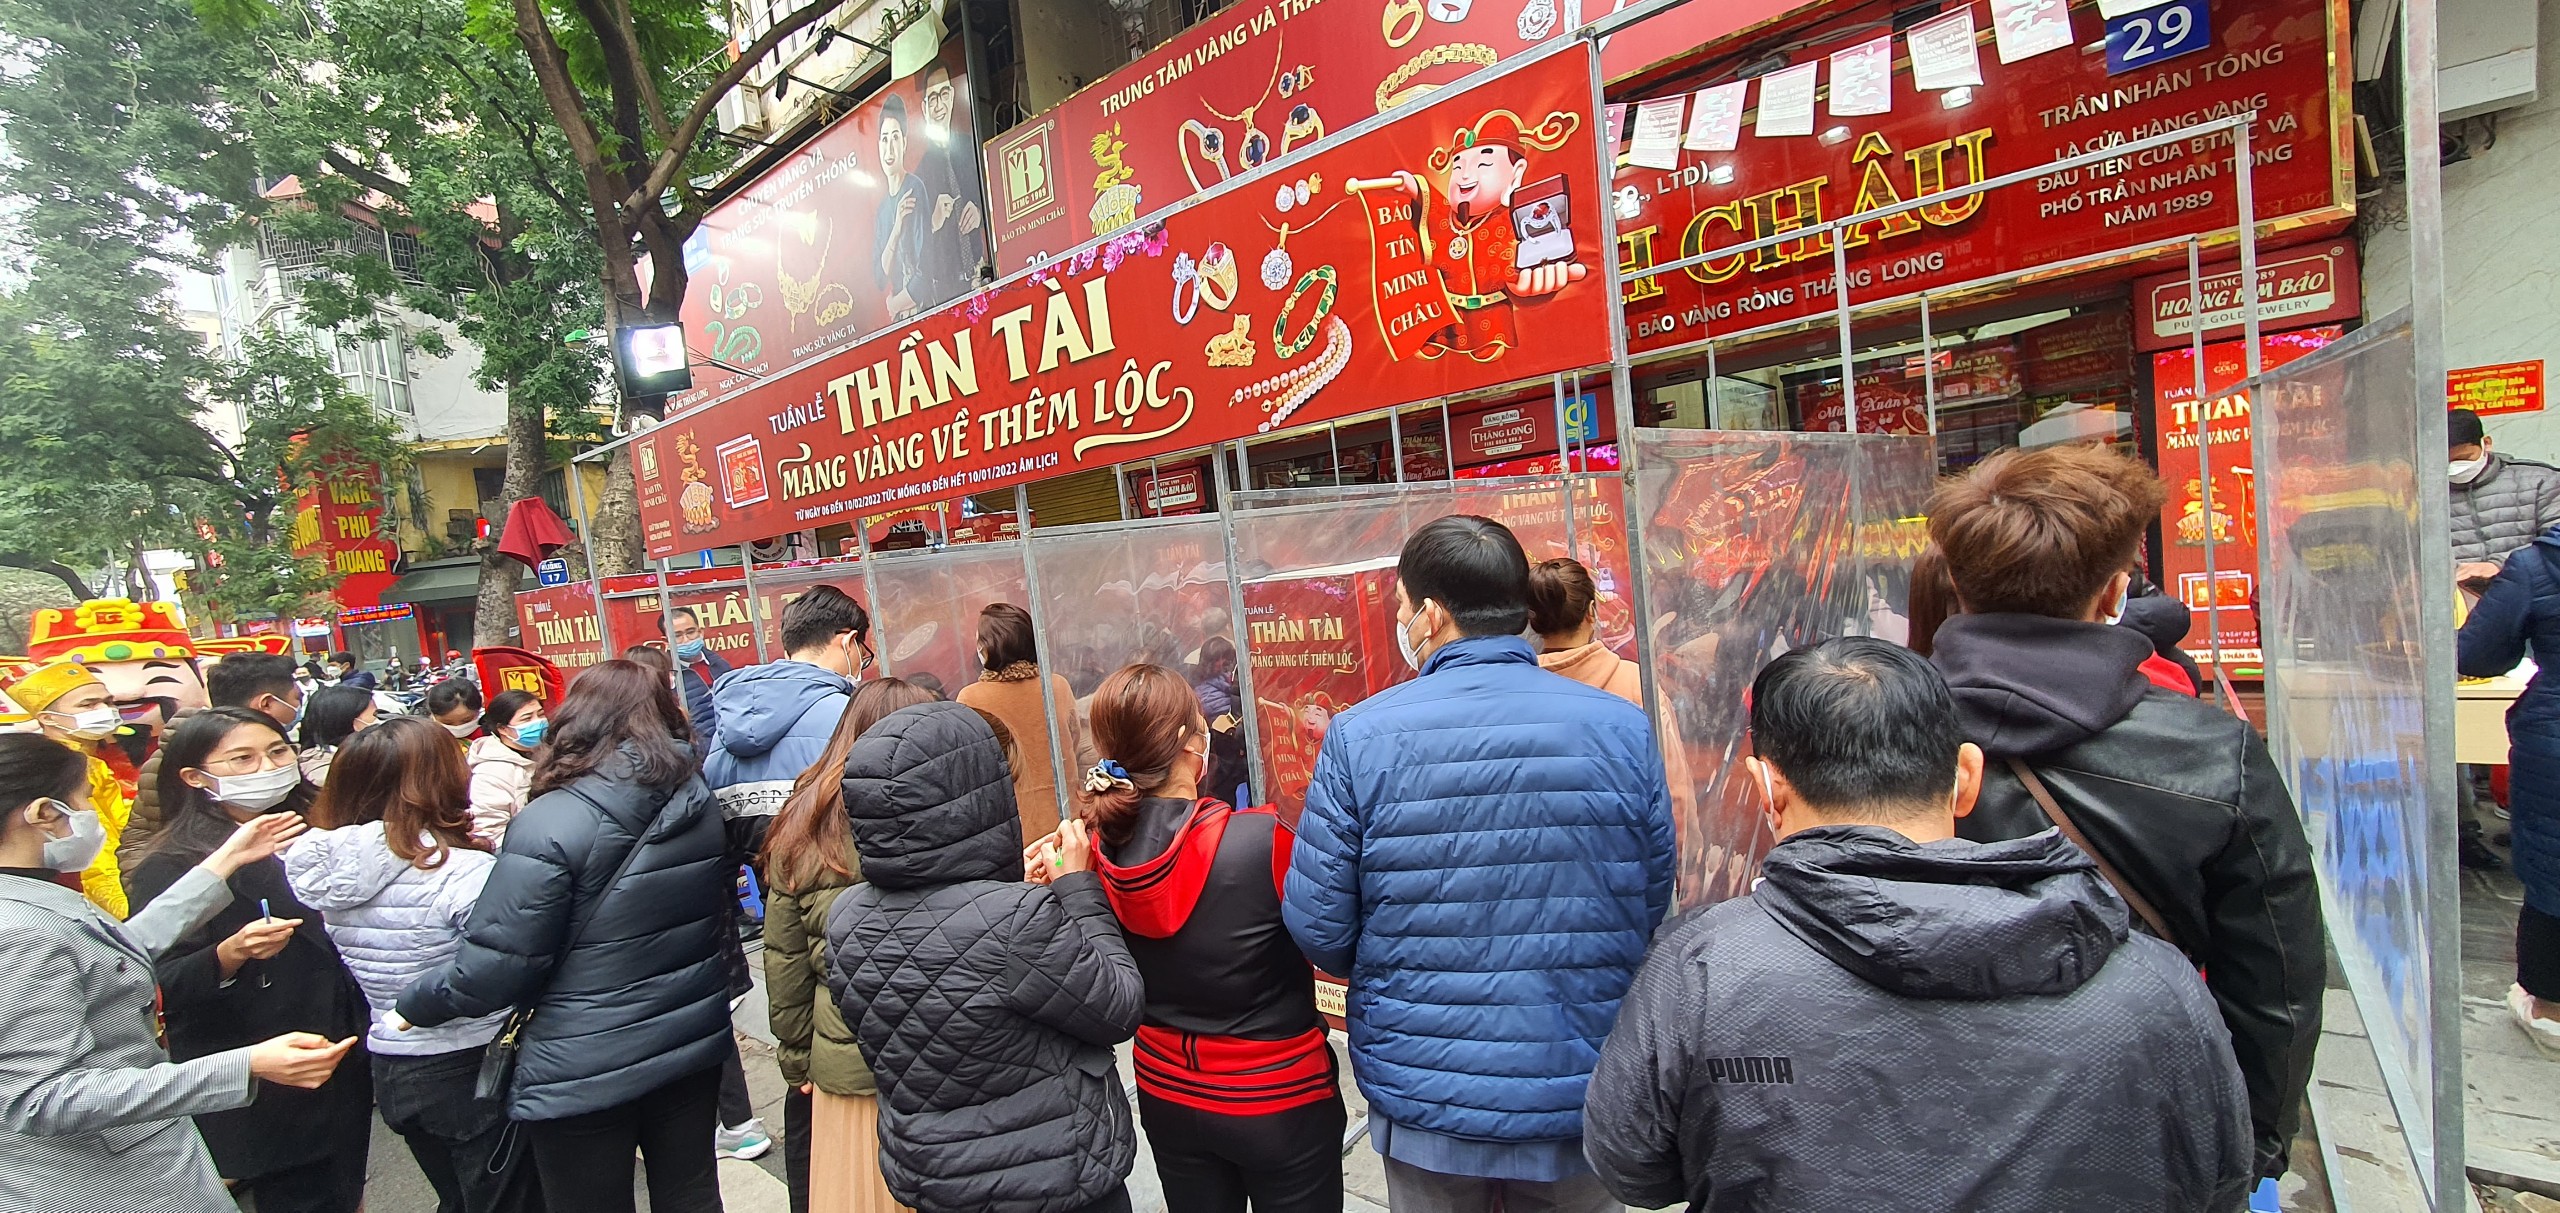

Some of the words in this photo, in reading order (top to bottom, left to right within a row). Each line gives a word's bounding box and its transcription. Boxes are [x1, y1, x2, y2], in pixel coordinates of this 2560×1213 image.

[2122, 6, 2193, 62] 29
[1100, 75, 1155, 118] TRUNG
[1155, 53, 1193, 87] TÂM
[1195, 24, 1248, 66] VÀNG
[1249, 5, 1277, 36] VÀ
[2038, 93, 2109, 129] TRẦN
[2114, 68, 2192, 108] NHÂN
[2199, 43, 2285, 82] TÔNG
[2055, 141, 2081, 162] LÀ
[2132, 112, 2199, 141] HÀNG
[2202, 92, 2269, 121] VÀNG
[2267, 112, 2298, 134] VÀ
[1657, 160, 1709, 195] LTD)
[2040, 190, 2083, 219] PHỐ
[2086, 179, 2146, 204] TRẦN
[2150, 162, 2217, 192] NHÂN
[1377, 200, 1413, 226] BẢO
[1681, 128, 1992, 284] CHÂU
[2104, 202, 2157, 228] NĂM
[2163, 190, 2214, 214] 1989
[1385, 235, 1415, 260] TÍN
[1382, 269, 1428, 300] MINH
[1638, 313, 1675, 340] BẢO
[1681, 304, 1731, 328] VÀNG
[1737, 287, 1794, 315] RỒNG
[1882, 252, 1944, 282] LONG
[2159, 290, 2230, 317] HONG
[2278, 270, 2325, 295] BẢO
[2204, 276, 2242, 291] BTMC
[1390, 301, 1442, 337] CHÂU
[2174, 318, 2205, 330] PUE
[2210, 310, 2246, 324] GOLD
[2257, 299, 2311, 315] EWELRY
[827, 330, 980, 435] THẦN
[992, 275, 1117, 382] TÀI
[768, 404, 806, 434] TUẦN
[808, 392, 826, 422] LỄ
[853, 433, 925, 483] VÀNG
[930, 412, 971, 463] VỀ
[978, 387, 1080, 451] THÊM
[1094, 357, 1173, 428] LỘC
[1506, 424, 1533, 436] LONG
[821, 506, 830, 516] 06
[844, 494, 881, 511] 10/02/2022
[922, 481, 931, 493] 06
[968, 462, 1017, 484] 10/01/2022
[1019, 456, 1034, 472] ÂM
[1036, 451, 1058, 472] LỊCH
[1558, 506, 1586, 523] TÊM
[548, 574, 560, 582] 17
[689, 591, 773, 628] HẦN
[704, 632, 750, 651] VÀNG
[1251, 612, 1305, 643] THẦN
[1309, 612, 1344, 640] TÀI
[1275, 651, 1297, 667] VÀNG
[1311, 650, 1335, 666] THÊM
[1337, 649, 1353, 668] LỘC
[1317, 985, 1341, 998] VÀNG
[1706, 1056, 1794, 1084] PUMA
